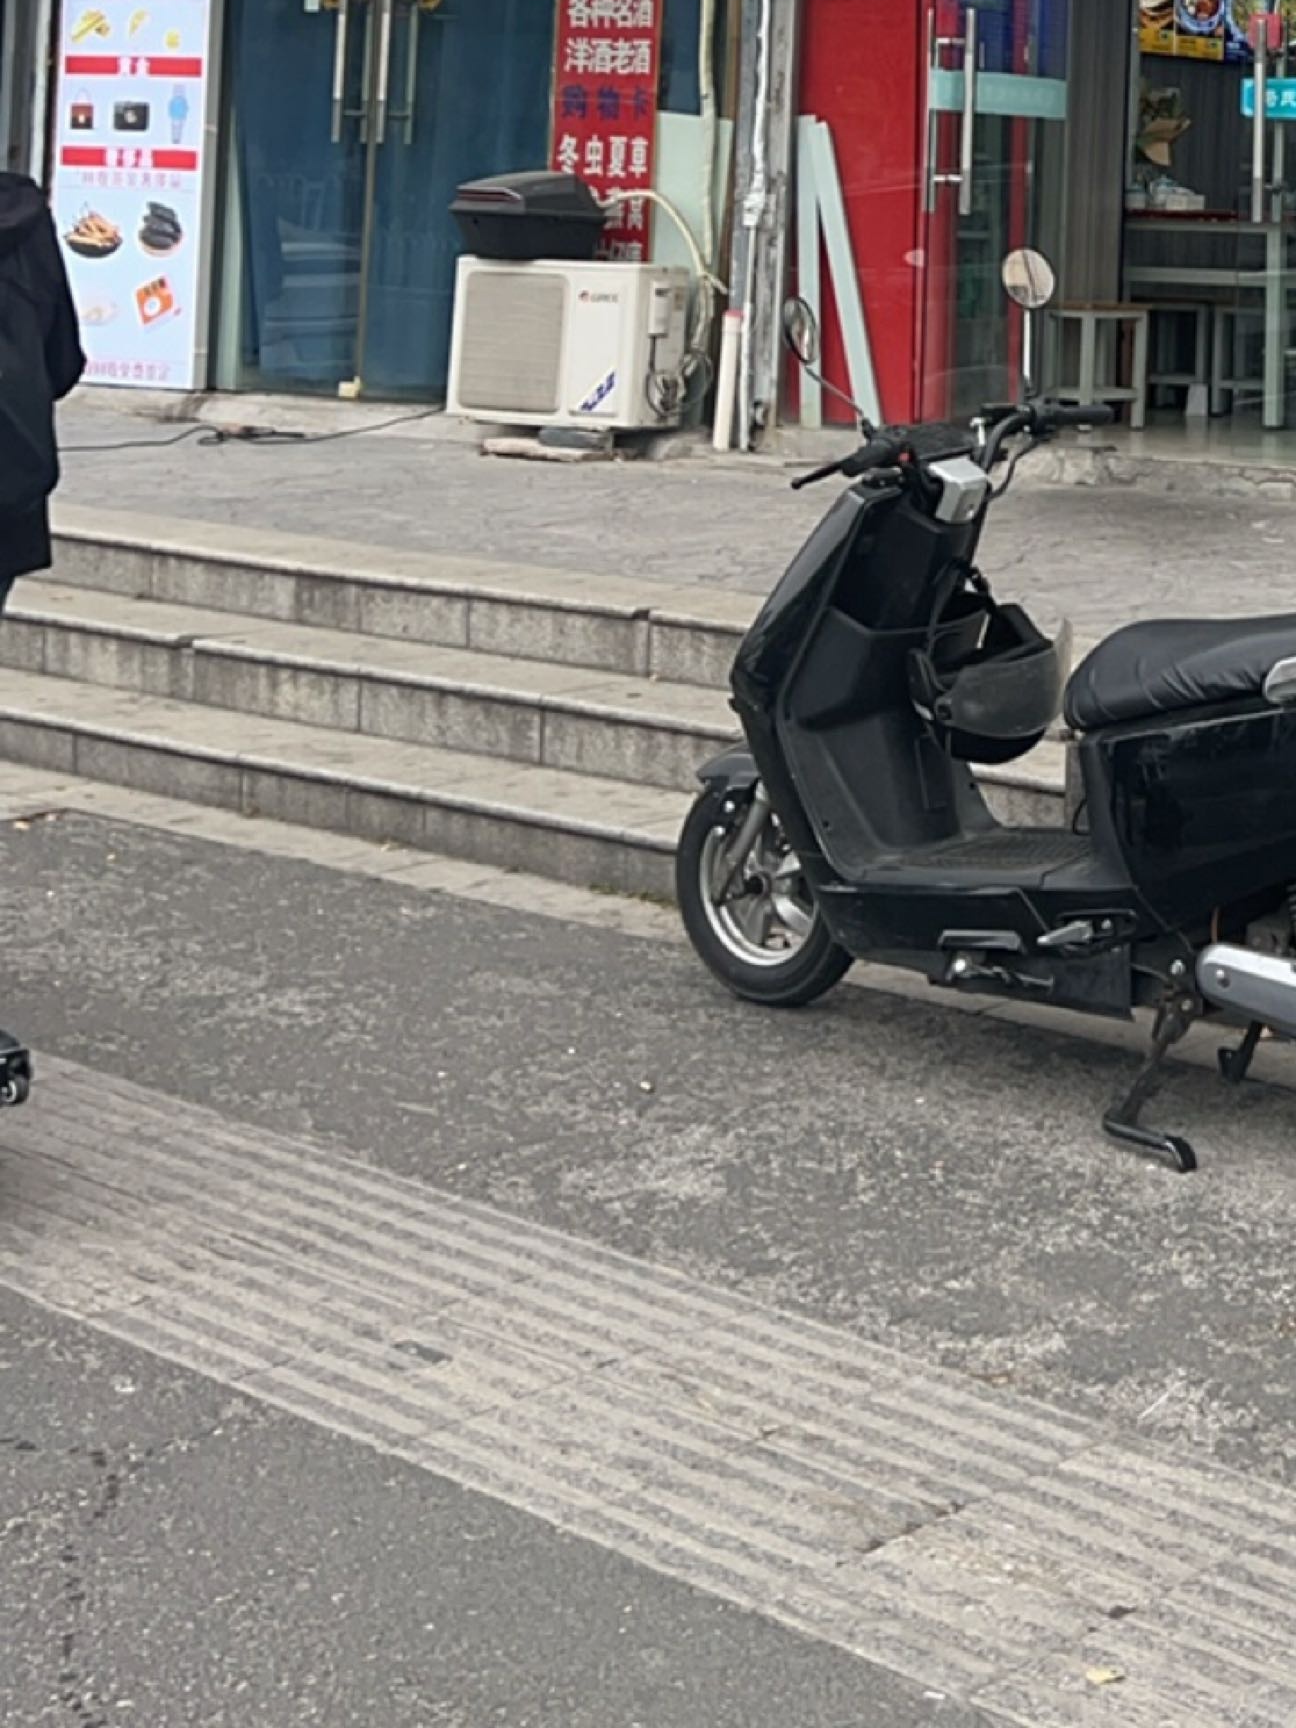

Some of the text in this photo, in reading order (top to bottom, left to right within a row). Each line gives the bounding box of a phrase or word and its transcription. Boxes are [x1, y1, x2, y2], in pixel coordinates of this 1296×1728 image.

[564, 37, 652, 75] 洋酒老酒
[557, 134, 649, 179] 冬虫夏草
